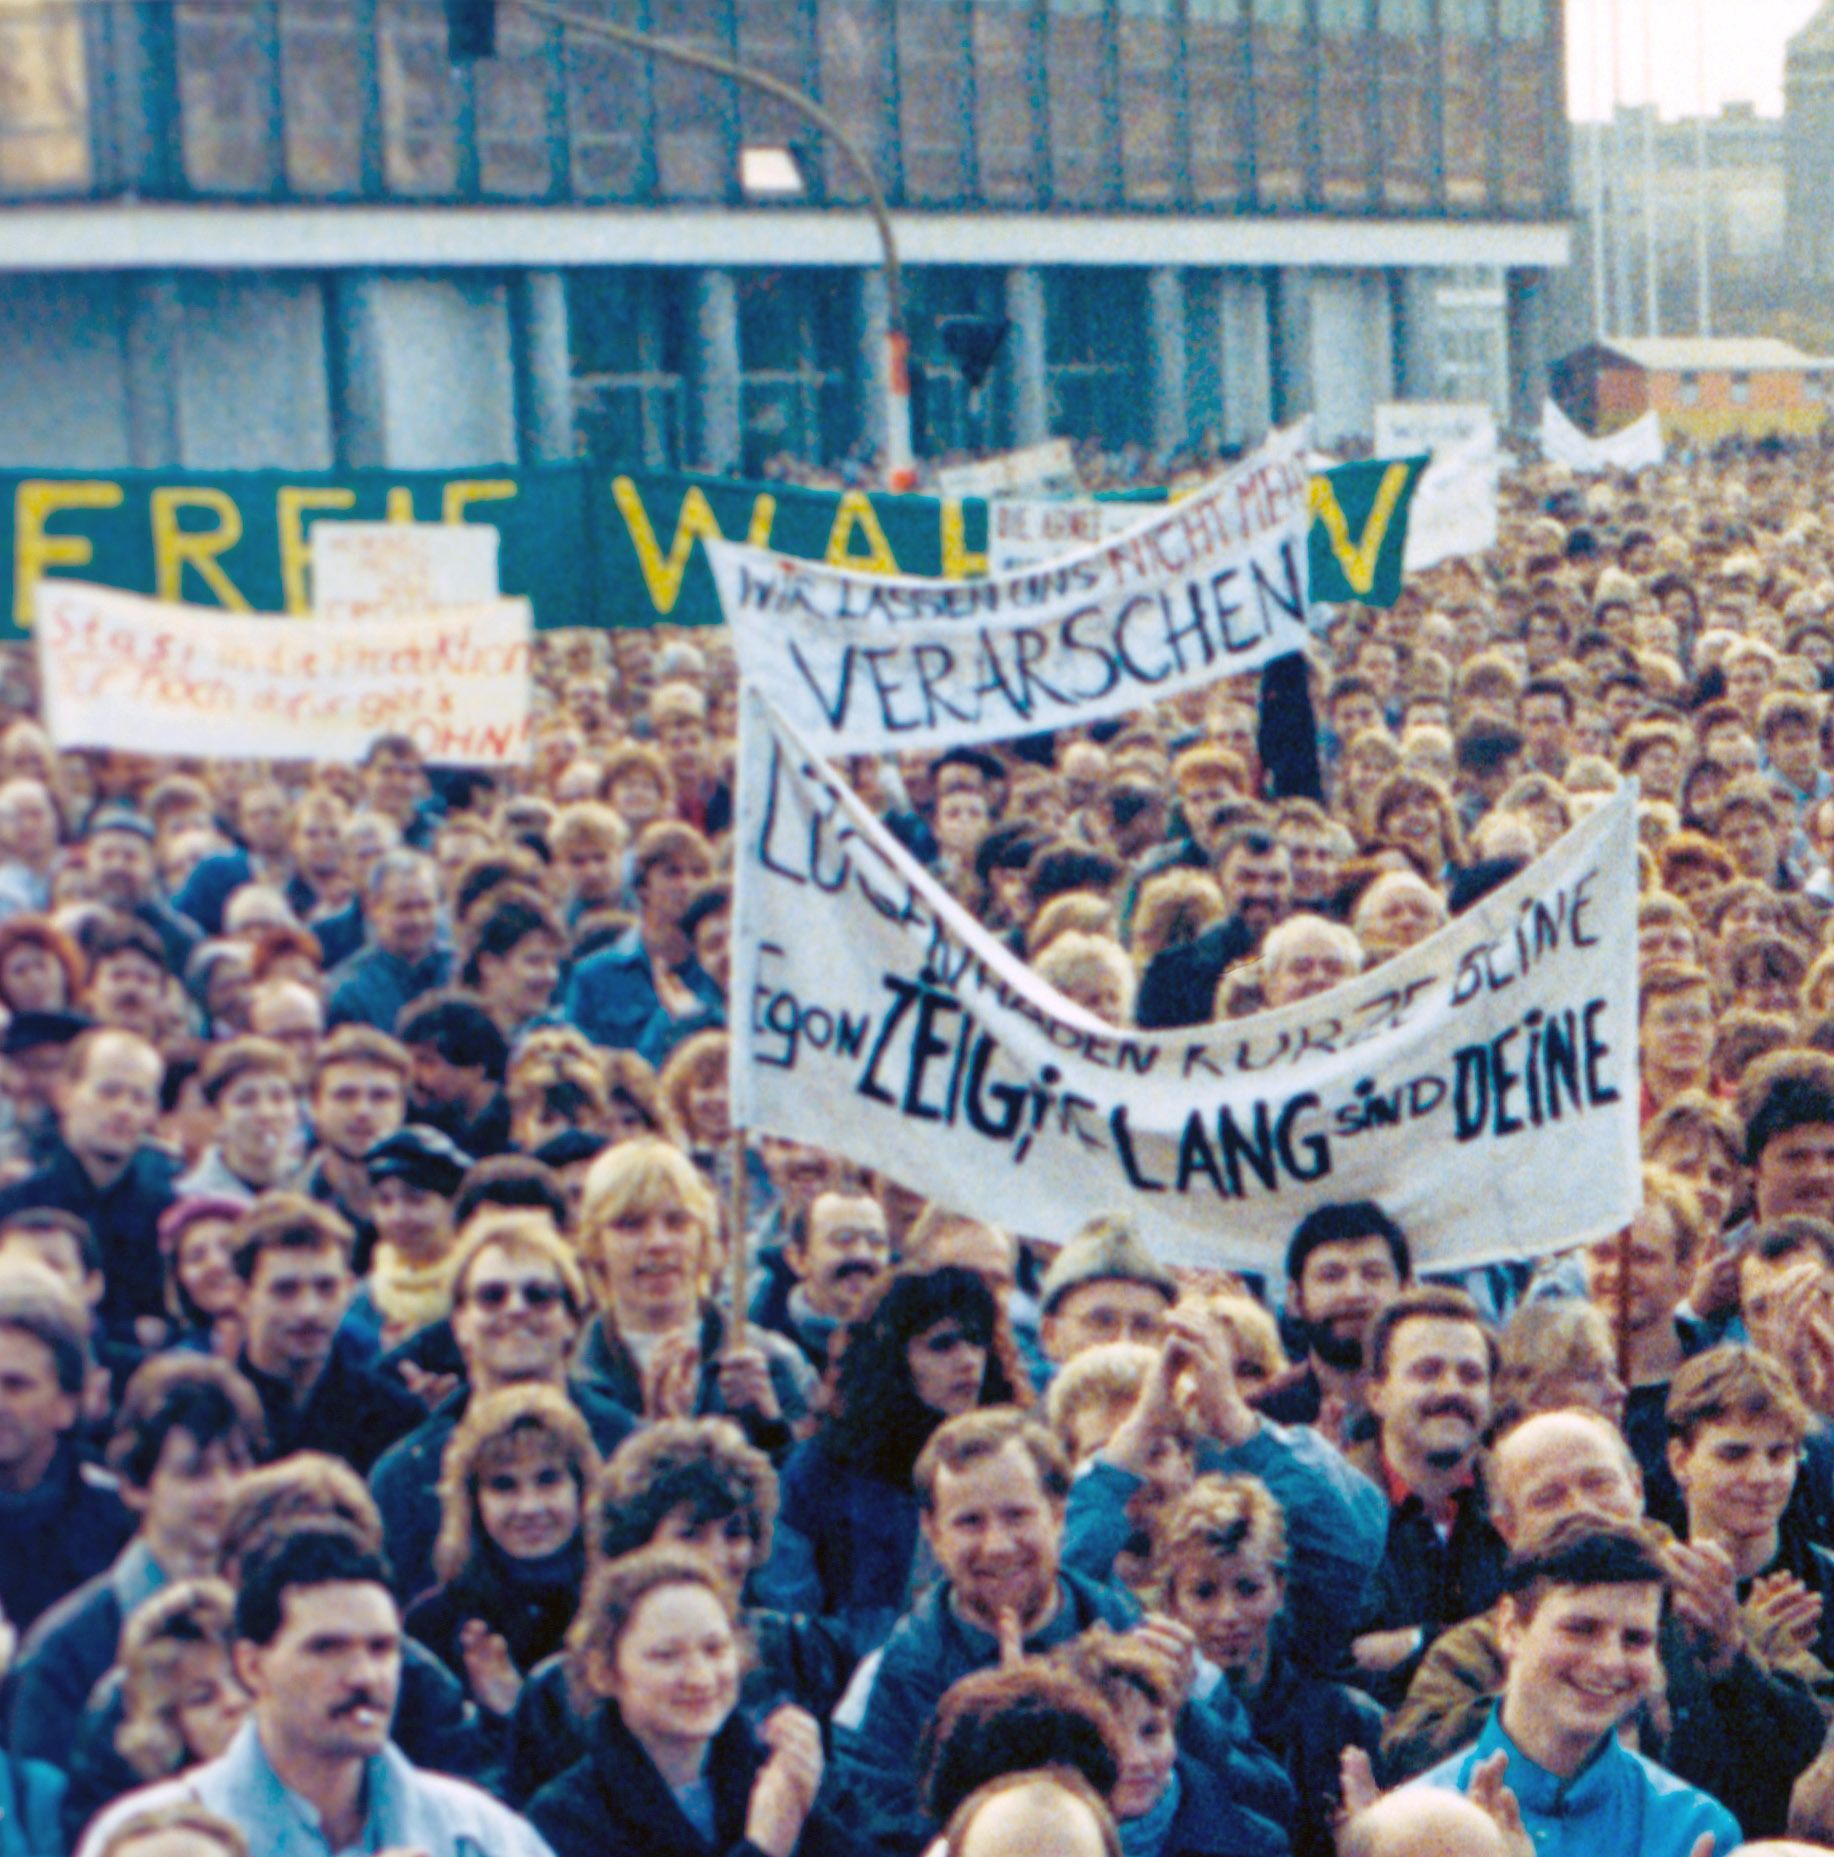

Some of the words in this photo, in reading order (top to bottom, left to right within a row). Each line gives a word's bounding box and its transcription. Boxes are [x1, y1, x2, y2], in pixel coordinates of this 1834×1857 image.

[1106, 495, 1231, 586] NICHT
[789, 542, 1305, 733] VERARSCHEN
[1111, 1092, 1332, 1199] LANG
